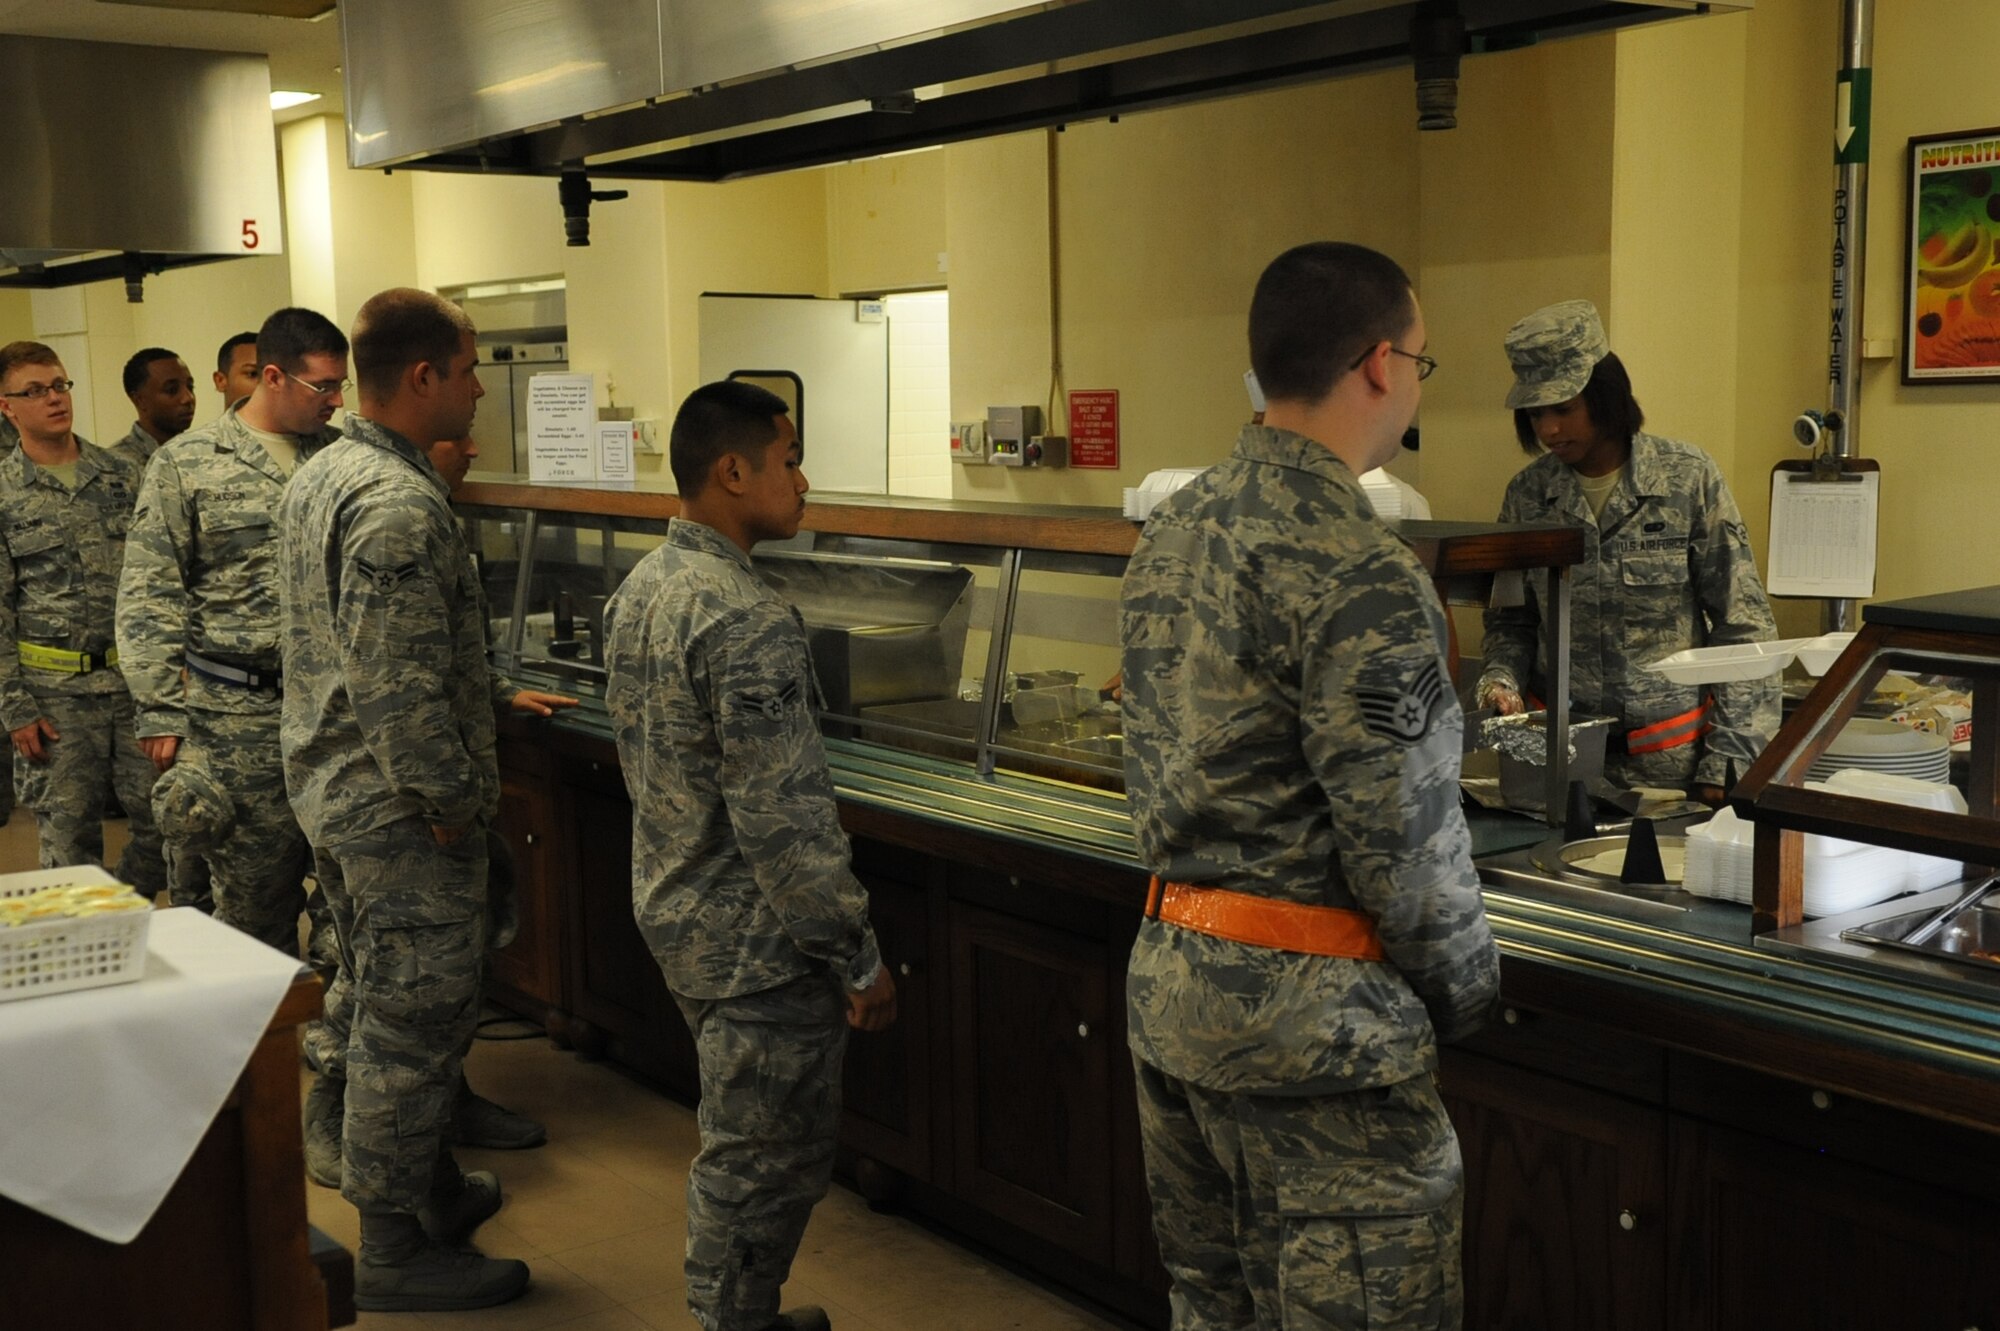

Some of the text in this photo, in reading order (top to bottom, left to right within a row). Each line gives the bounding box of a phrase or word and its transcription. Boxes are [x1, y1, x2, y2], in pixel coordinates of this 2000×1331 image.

[243, 220, 258, 249] 5
[1830, 190, 1846, 384] POTABLE WATER
